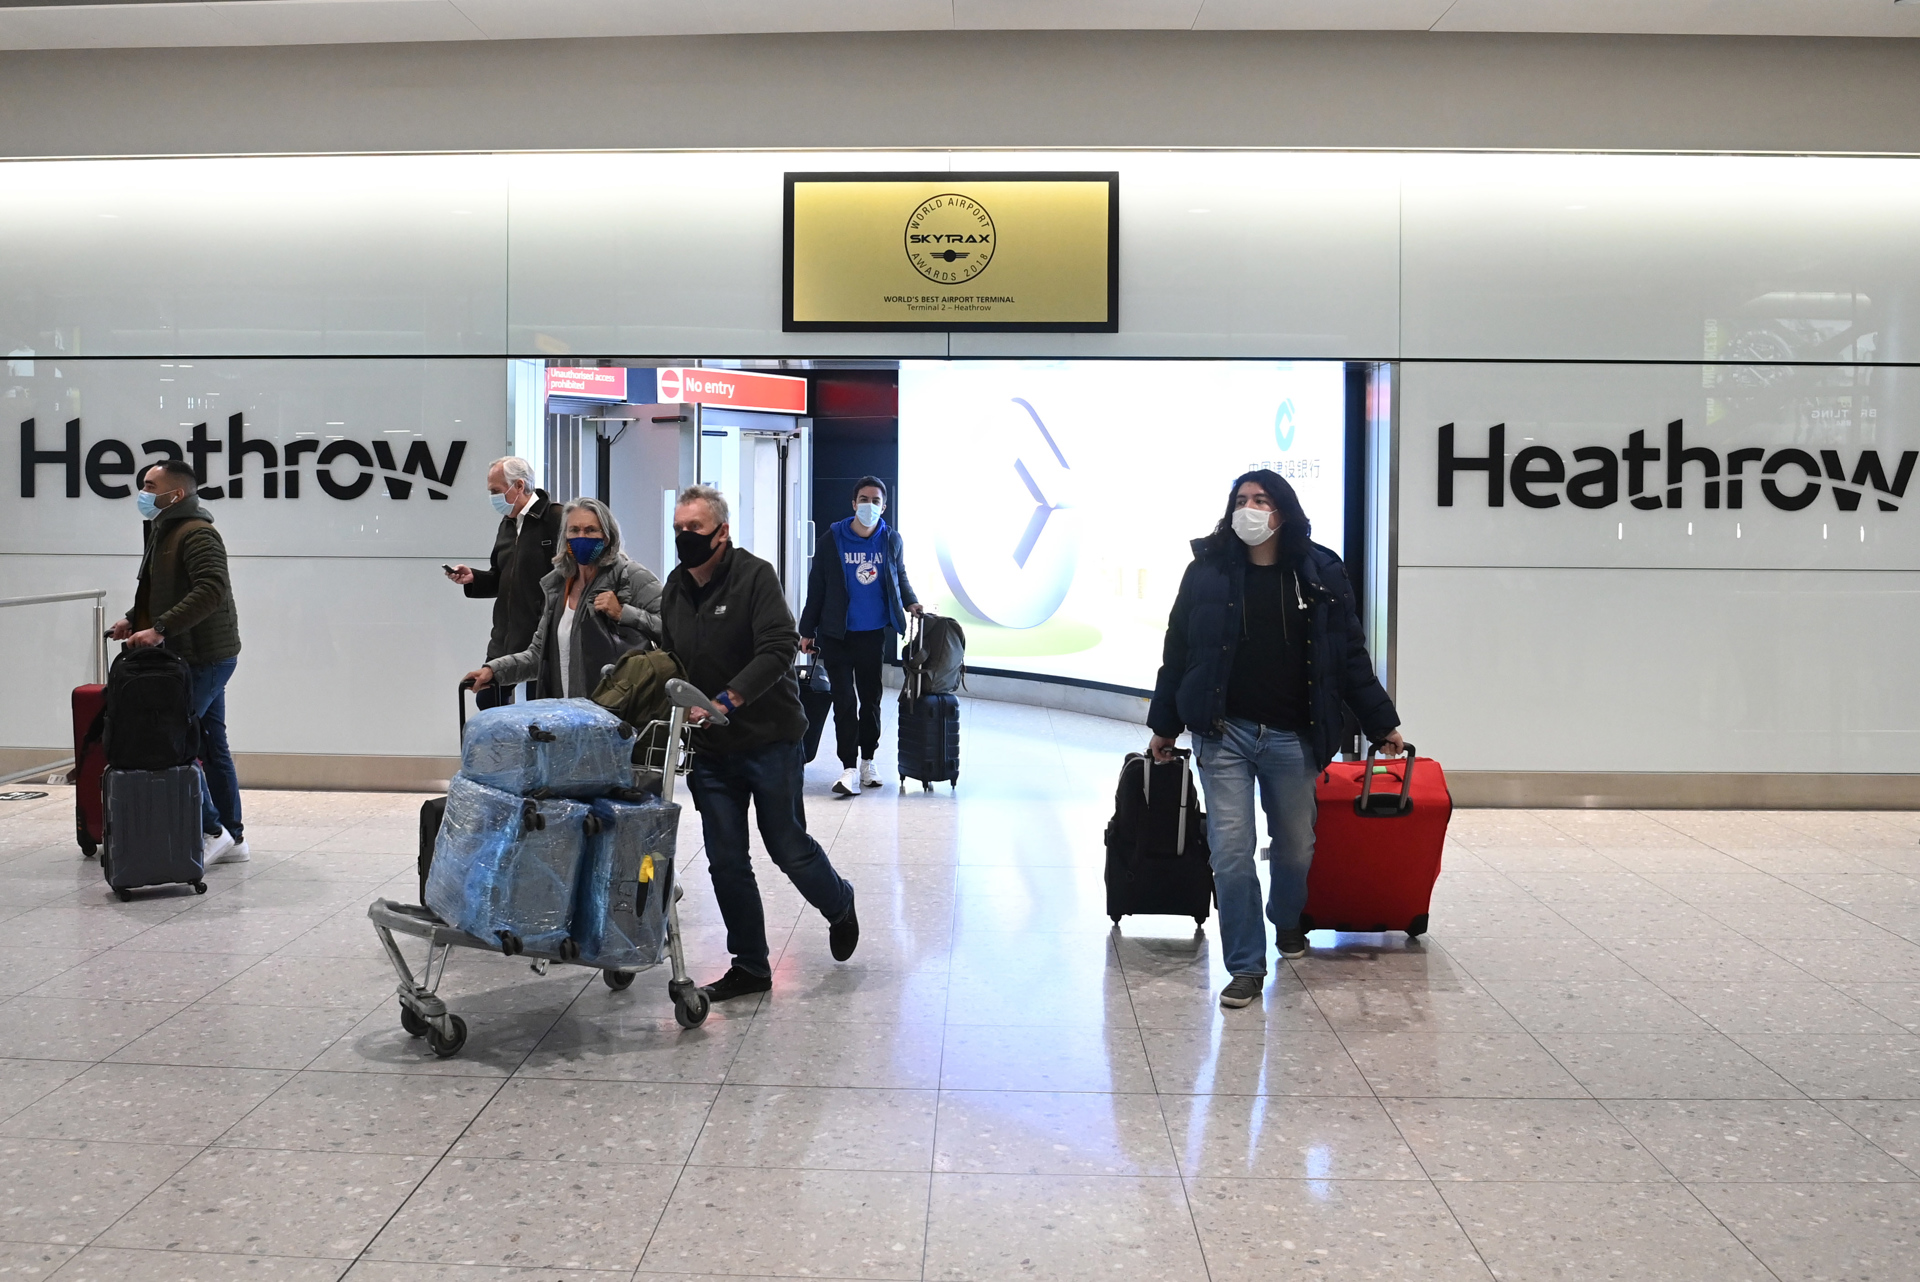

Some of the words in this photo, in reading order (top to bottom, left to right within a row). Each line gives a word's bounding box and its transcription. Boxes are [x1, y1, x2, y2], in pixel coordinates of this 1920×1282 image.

[910, 199, 943, 230] WORLD
[947, 197, 990, 229] AIRPORT
[909, 234, 991, 244] SKYTRAX
[911, 252, 957, 282] AWARDS
[963, 252, 988, 278] 2018
[883, 295, 919, 303] WORLD'S
[921, 295, 939, 303] BEST
[550, 369, 595, 381] Unauthorised
[595, 374, 616, 382] access
[550, 379, 585, 390] prohibited
[685, 377, 702, 393] No
[704, 380, 735, 398] entry
[1437, 418, 1919, 511] Heathrow
[844, 552, 867, 564] BLUE
